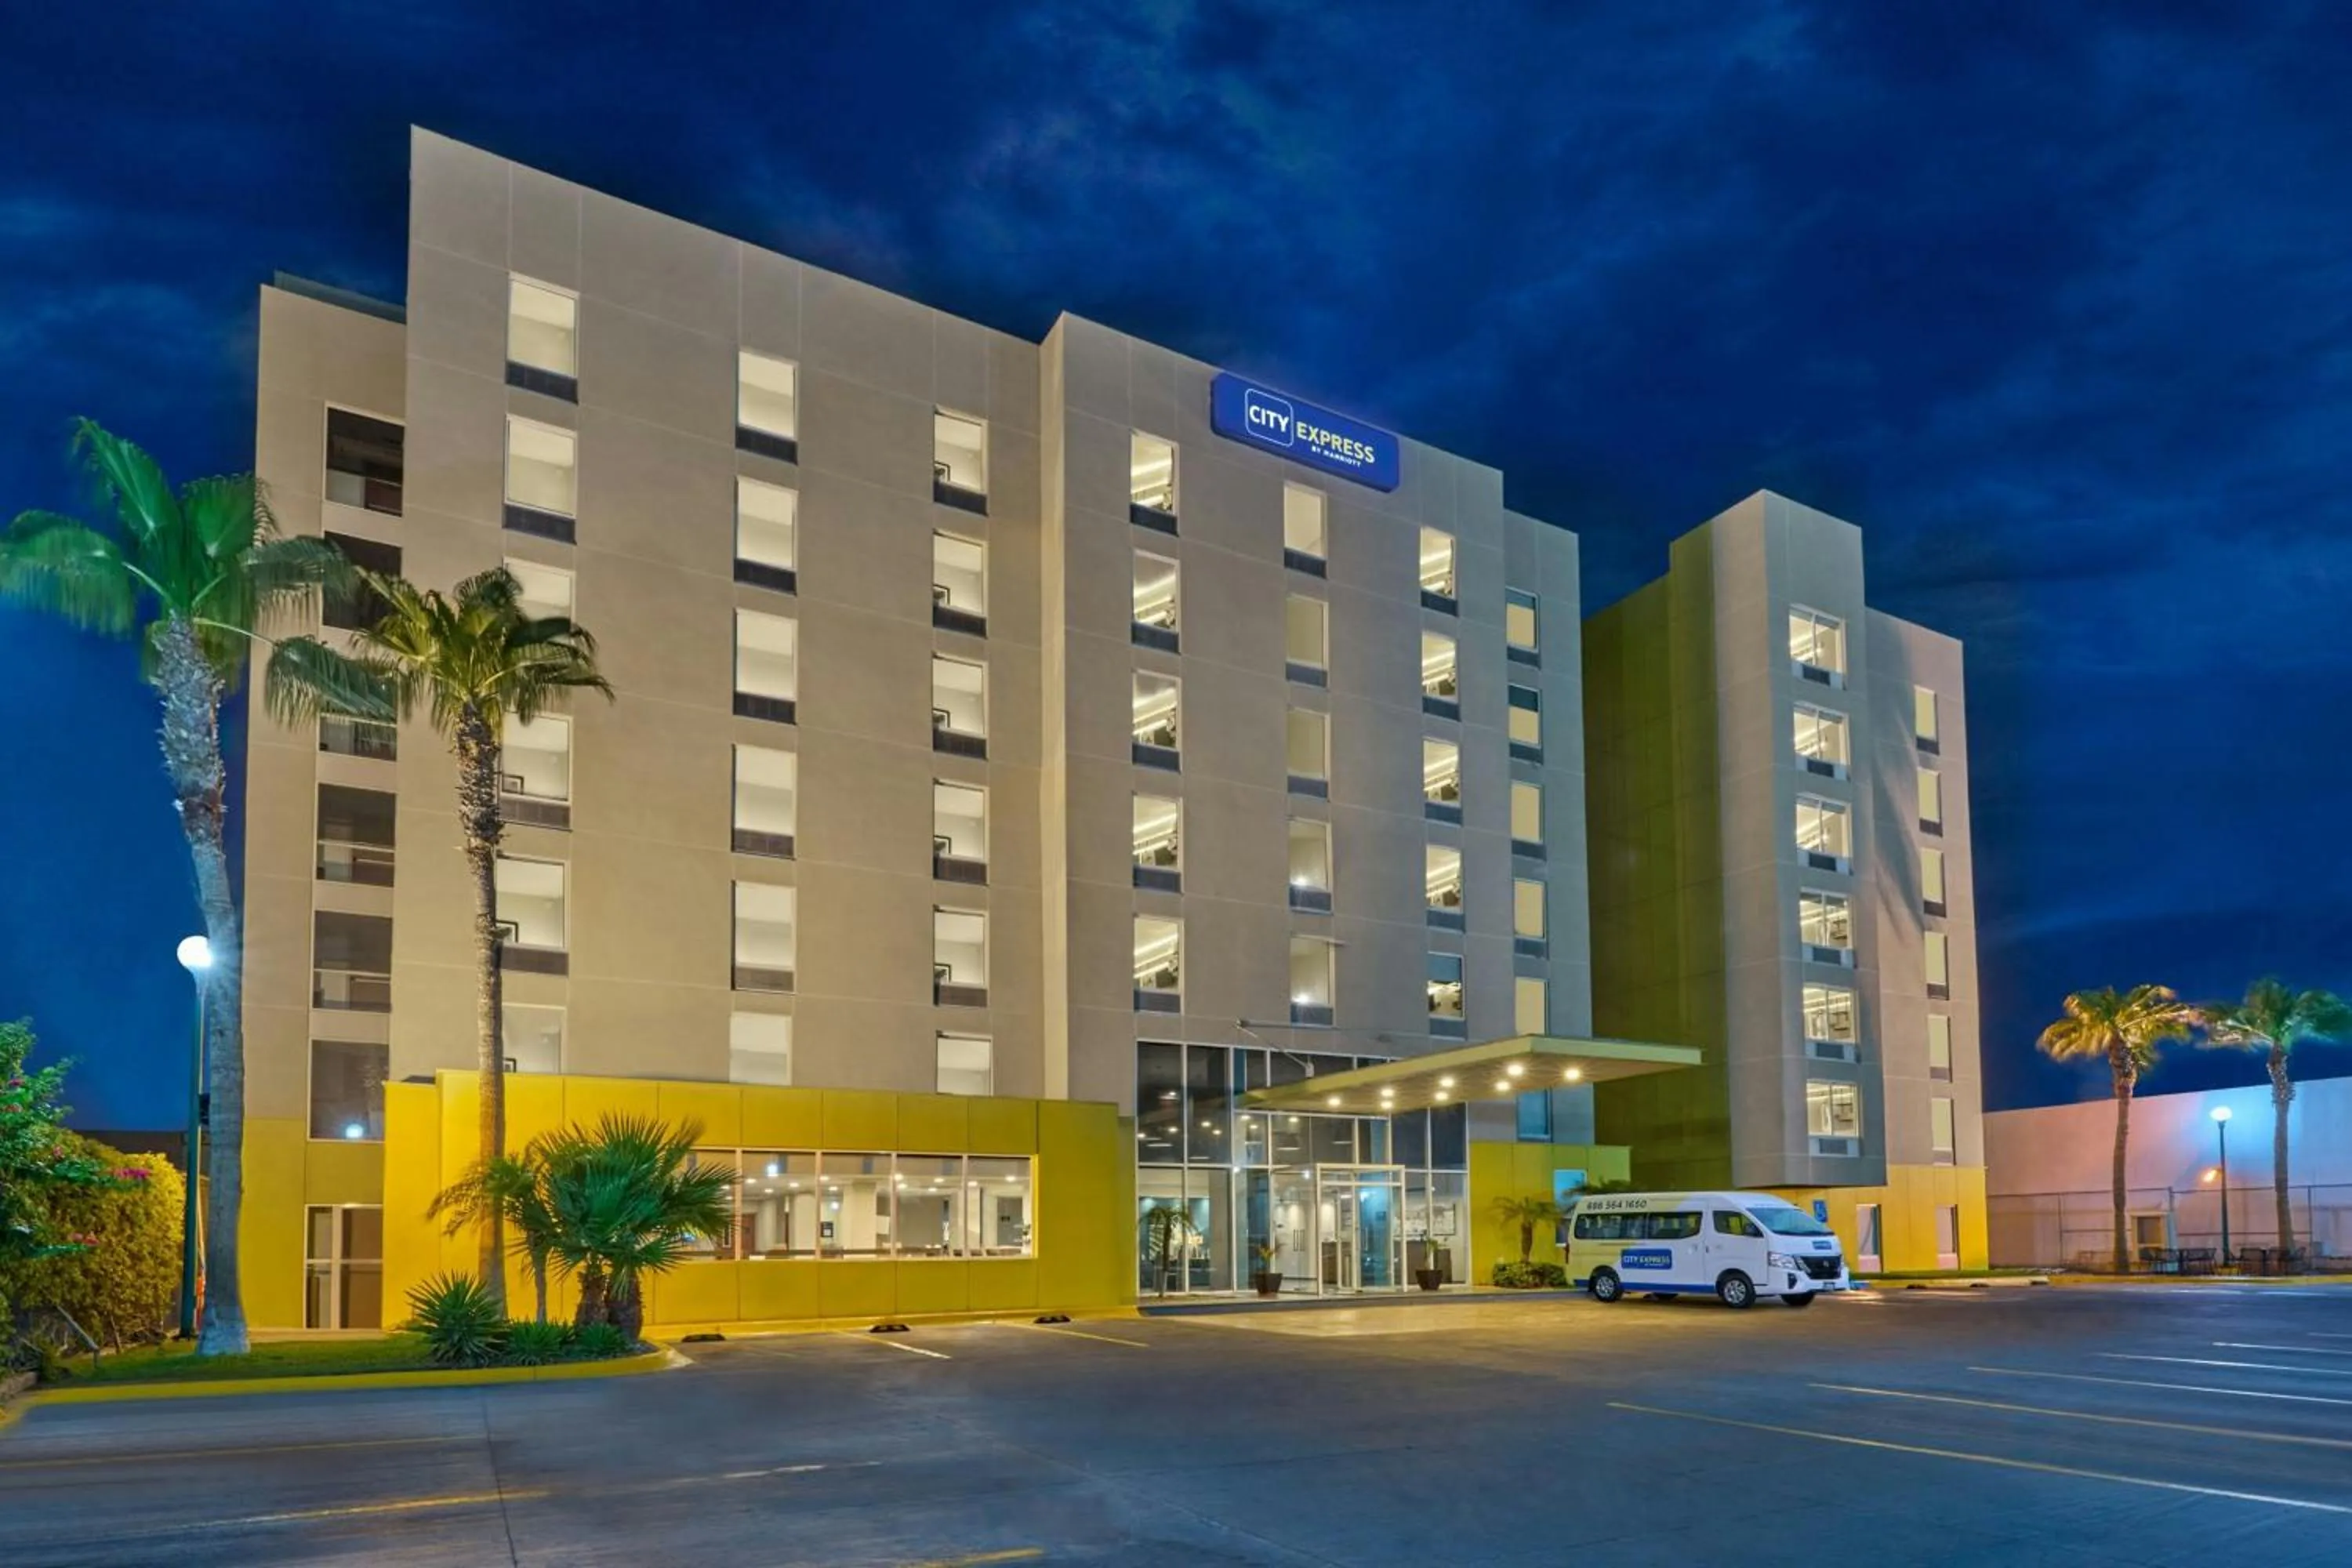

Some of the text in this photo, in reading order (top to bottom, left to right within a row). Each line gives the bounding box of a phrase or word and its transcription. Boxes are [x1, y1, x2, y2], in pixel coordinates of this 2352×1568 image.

[1249, 405, 1375, 464] CITY EXPRESS
[1312, 445, 1361, 468] BY MARRIOTT
